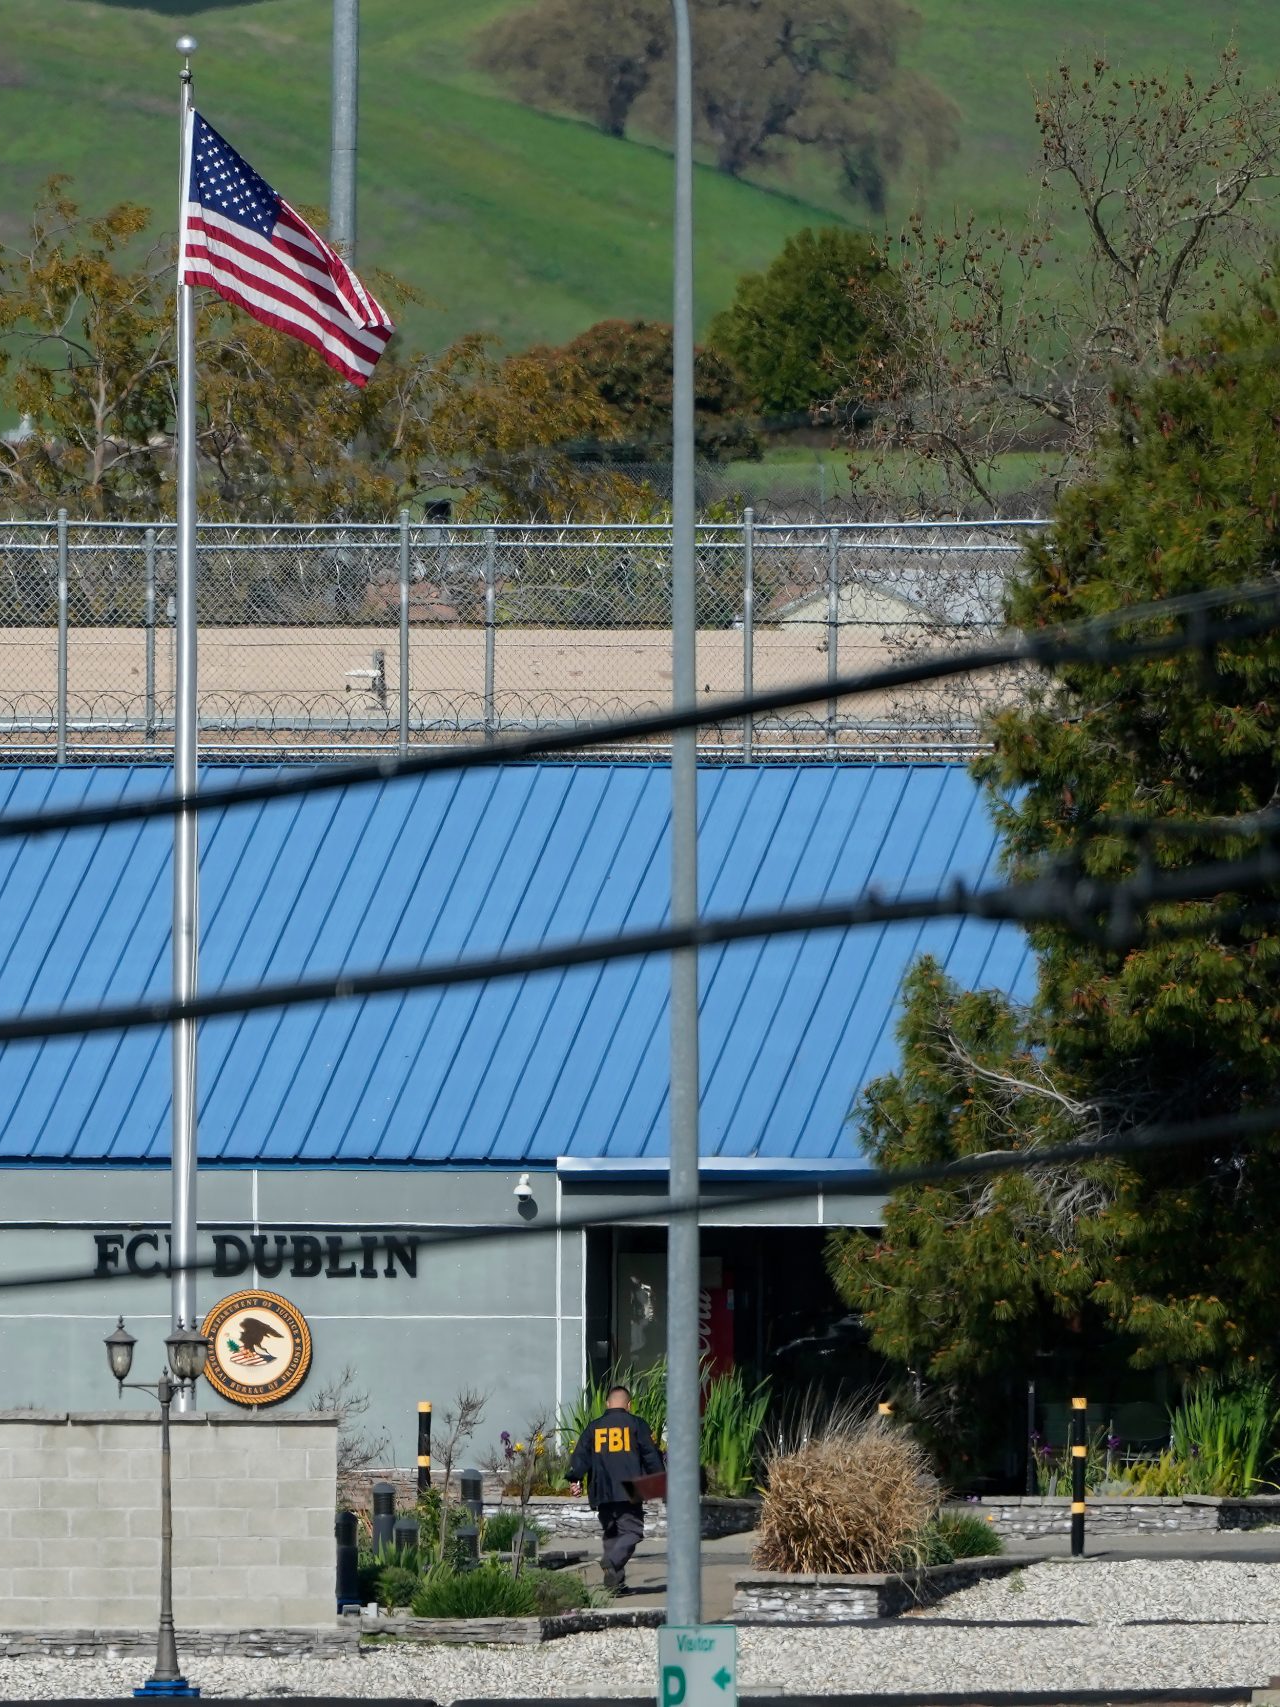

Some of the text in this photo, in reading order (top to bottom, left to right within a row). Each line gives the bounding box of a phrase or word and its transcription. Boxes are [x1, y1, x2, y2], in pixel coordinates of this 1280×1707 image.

[211, 1234, 420, 1278] DUBLIN
[212, 1299, 300, 1336] DEPARTMENT OF JUSTICE
[268, 1381, 279, 1391] OF
[282, 1346, 301, 1381] PRISONS
[594, 1427, 631, 1453] FBI
[676, 1634, 716, 1652] Visitor
